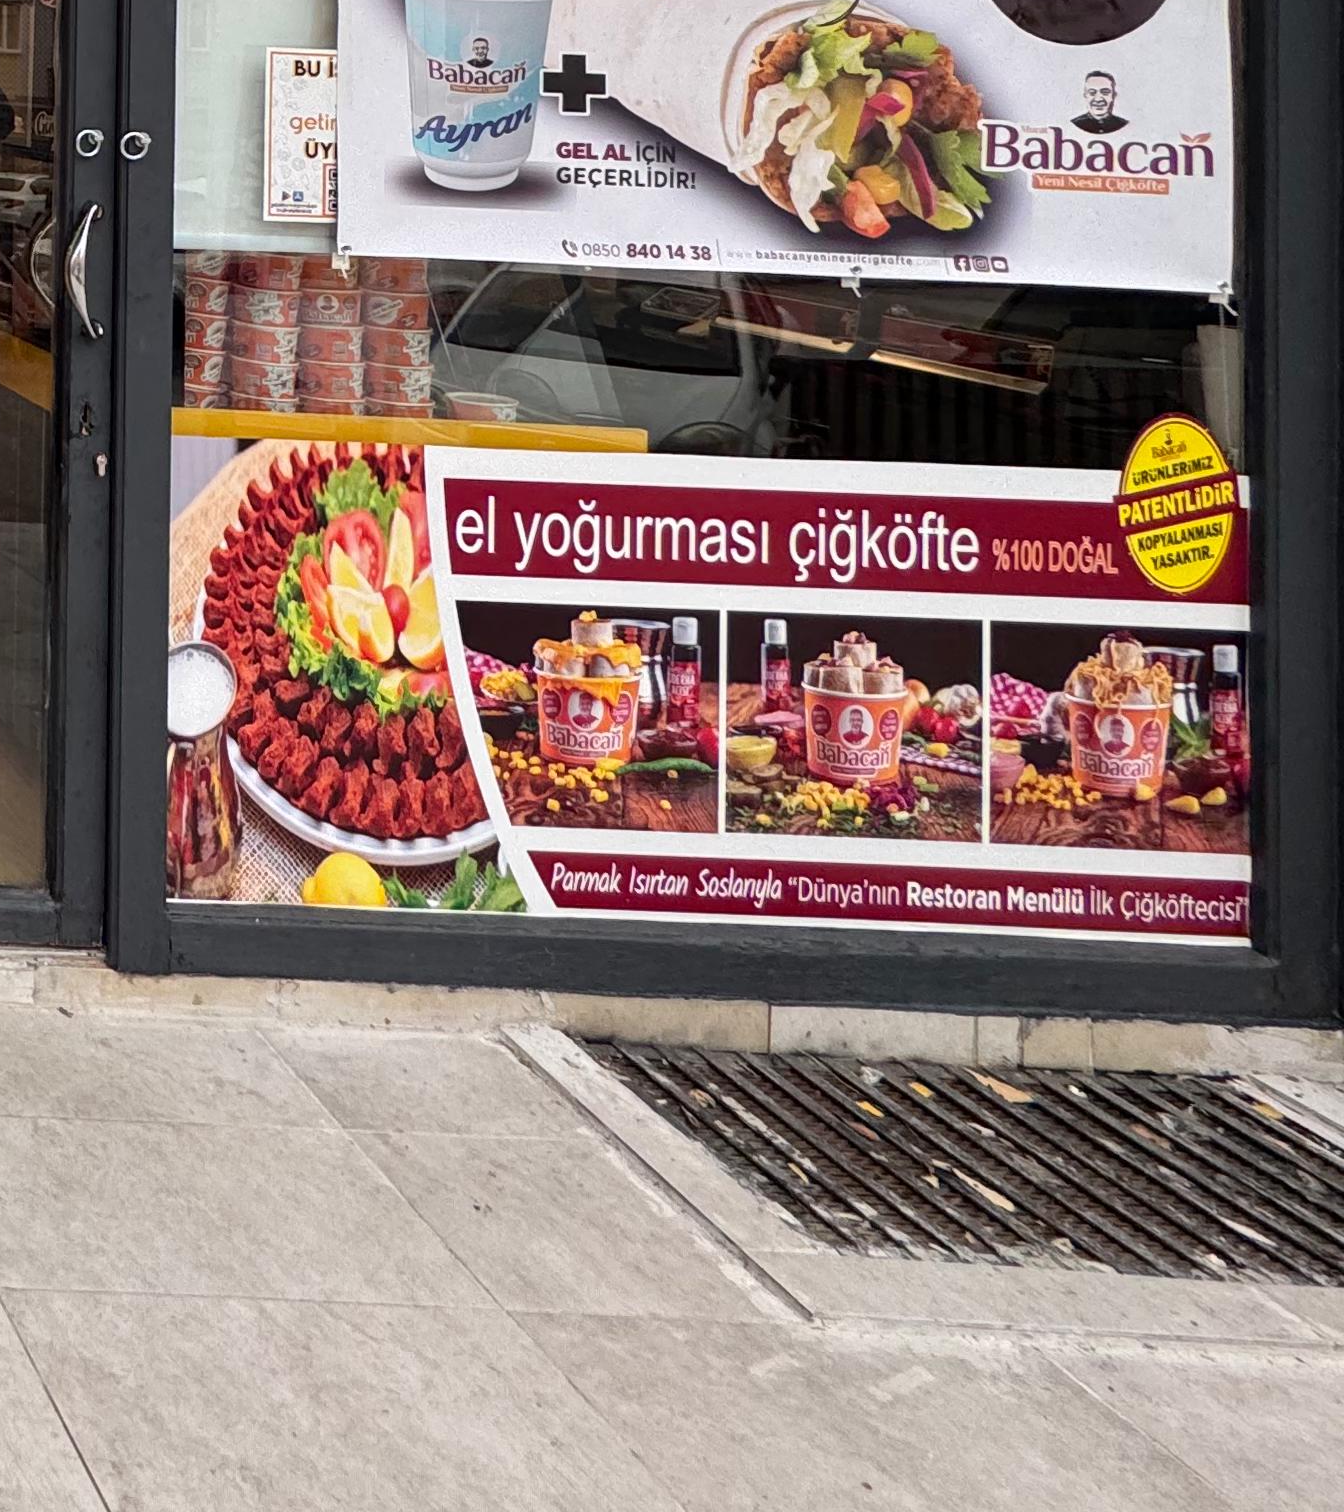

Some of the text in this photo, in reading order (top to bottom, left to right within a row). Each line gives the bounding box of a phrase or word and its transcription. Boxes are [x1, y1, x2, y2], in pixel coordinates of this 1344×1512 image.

[293, 59, 321, 77] BU
[415, 102, 532, 152] Ayran
[556, 142, 676, 164] GEL AL İÇİN
[556, 167, 696, 189] GEÇERLİDİR!
[1037, 175, 1064, 187] Yeni
[1067, 175, 1102, 189] Nesil
[582, 243, 712, 261] 0850 840 14 38
[455, 495, 1119, 584] el yoğurması çiğköfte %100 DOĞAL
[1138, 522, 1223, 552] KOPYALANMASI
[551, 862, 621, 894] Parmak
[696, 867, 782, 909] Soslarıyla
[907, 881, 1002, 911] Restoran
[1007, 886, 1085, 915] Menülü
[1090, 885, 1114, 916] İlk
